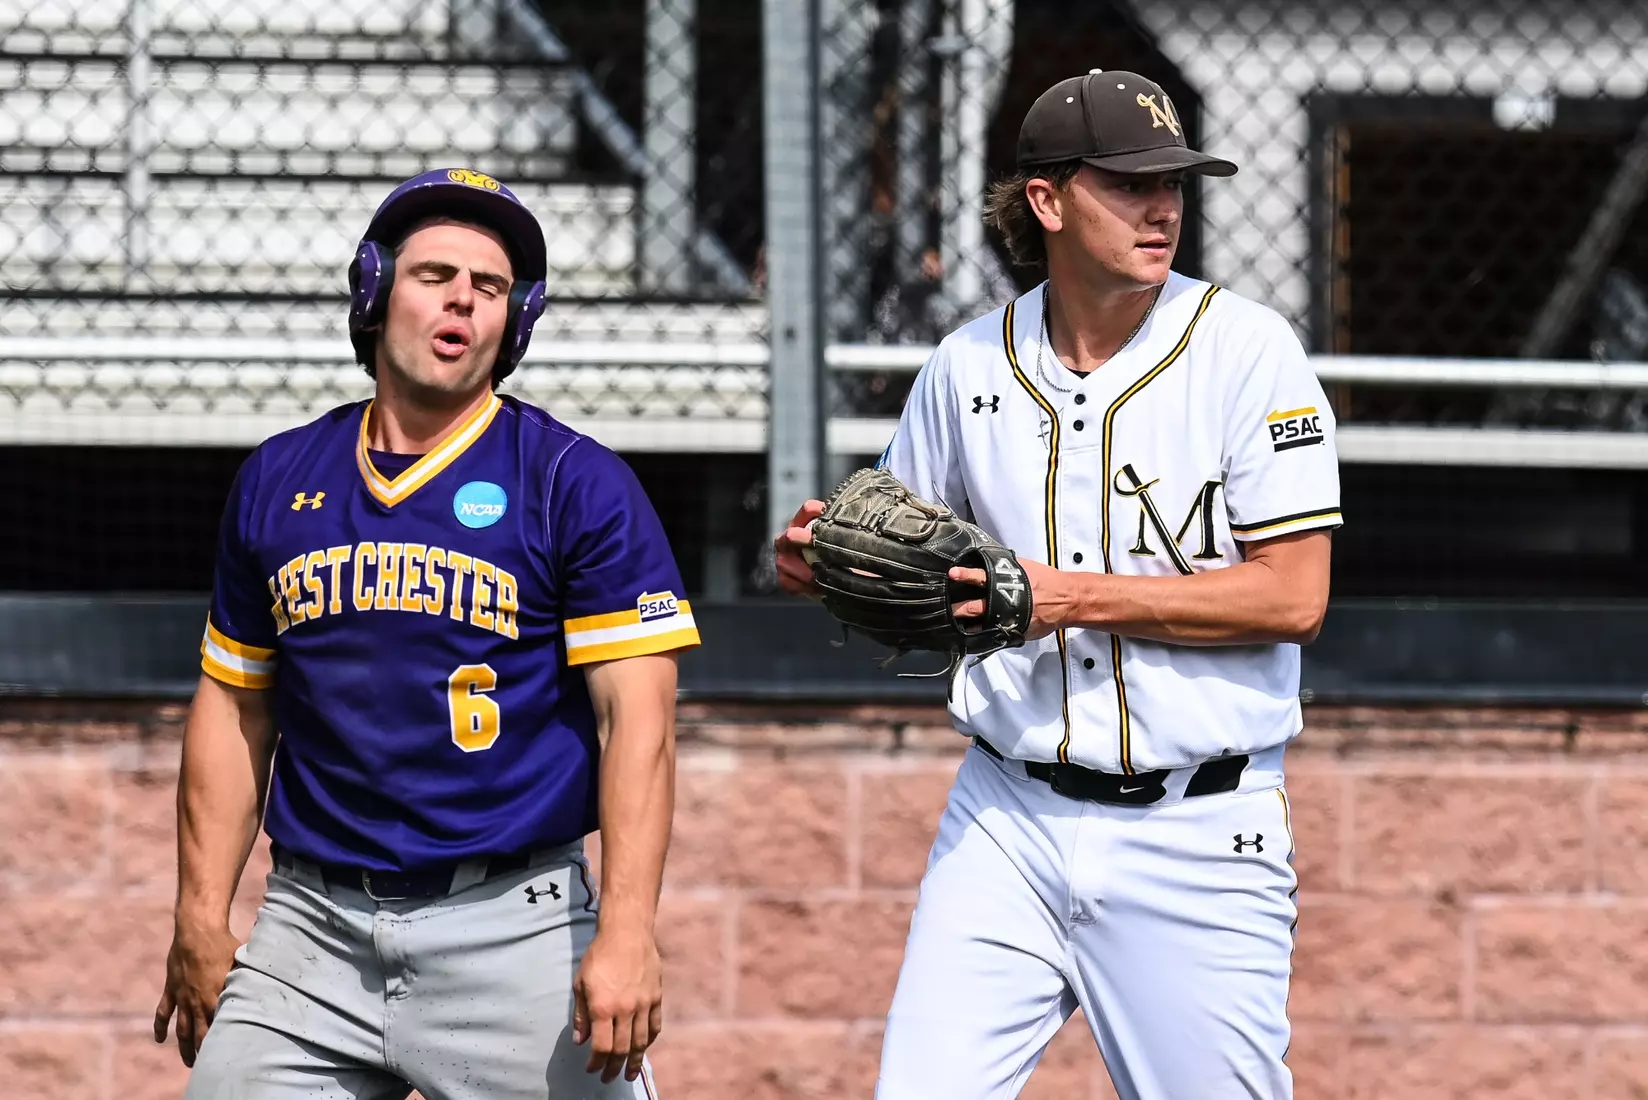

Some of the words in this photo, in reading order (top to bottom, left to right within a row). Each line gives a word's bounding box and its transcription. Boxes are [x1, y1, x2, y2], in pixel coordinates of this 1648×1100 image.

[1268, 415, 1323, 442] PSAC
[460, 503, 504, 516] NCAA
[1113, 463, 1223, 576] M
[352, 541, 519, 641] CHESTER
[639, 598, 677, 616] PSAC
[447, 662, 501, 753] 6
